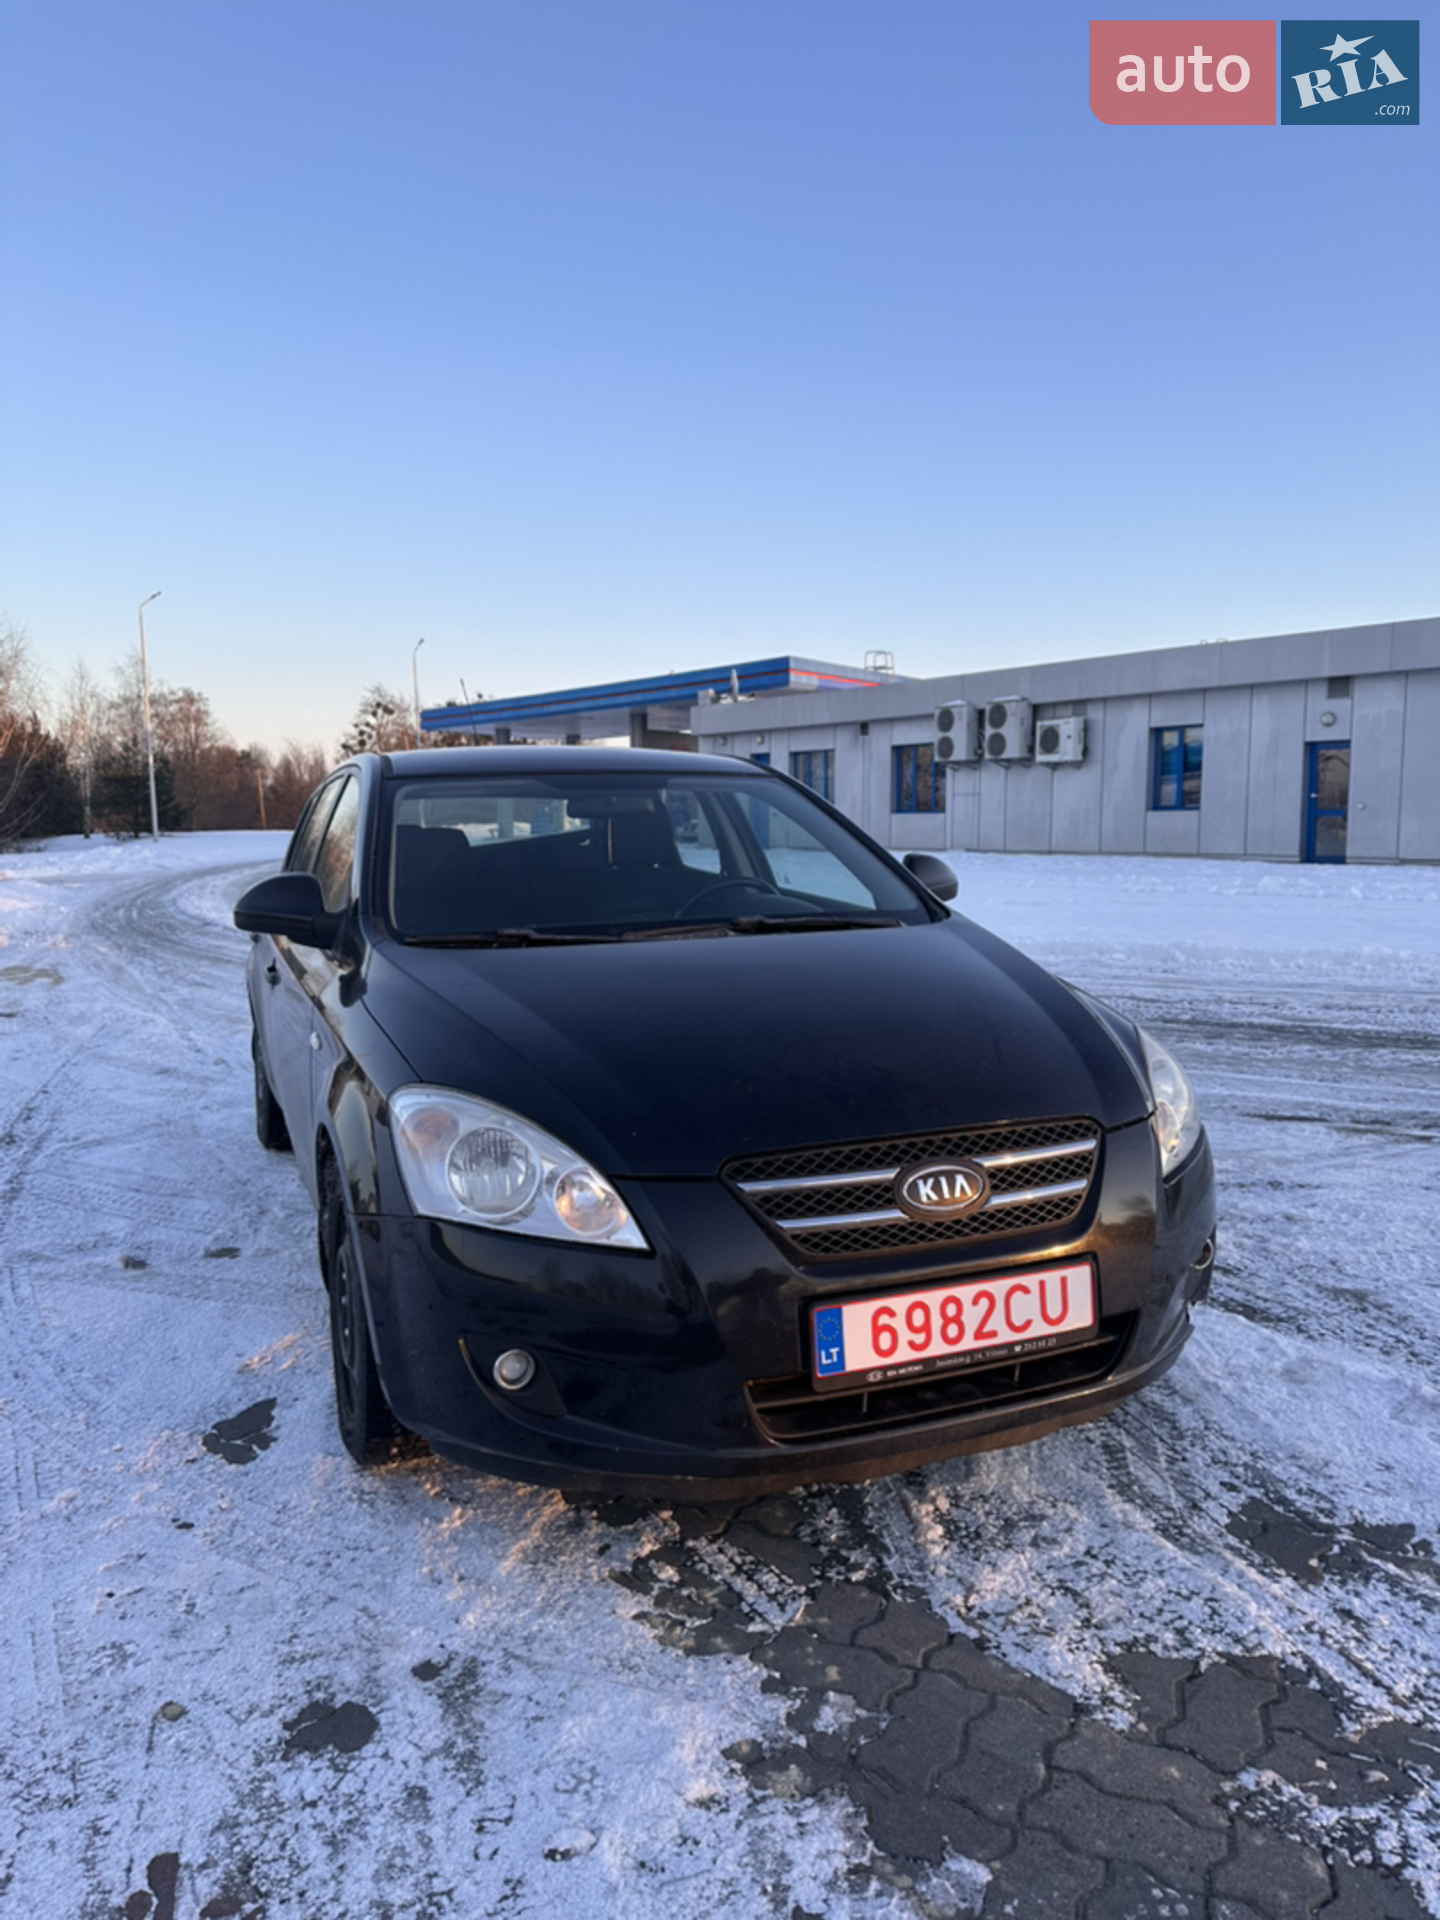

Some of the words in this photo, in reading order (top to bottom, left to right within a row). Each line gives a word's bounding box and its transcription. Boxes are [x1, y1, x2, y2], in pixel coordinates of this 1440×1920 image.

[915, 1173, 973, 1204] KIA
[820, 1347, 840, 1366] LT
[870, 1275, 1070, 1359] 6982CU
